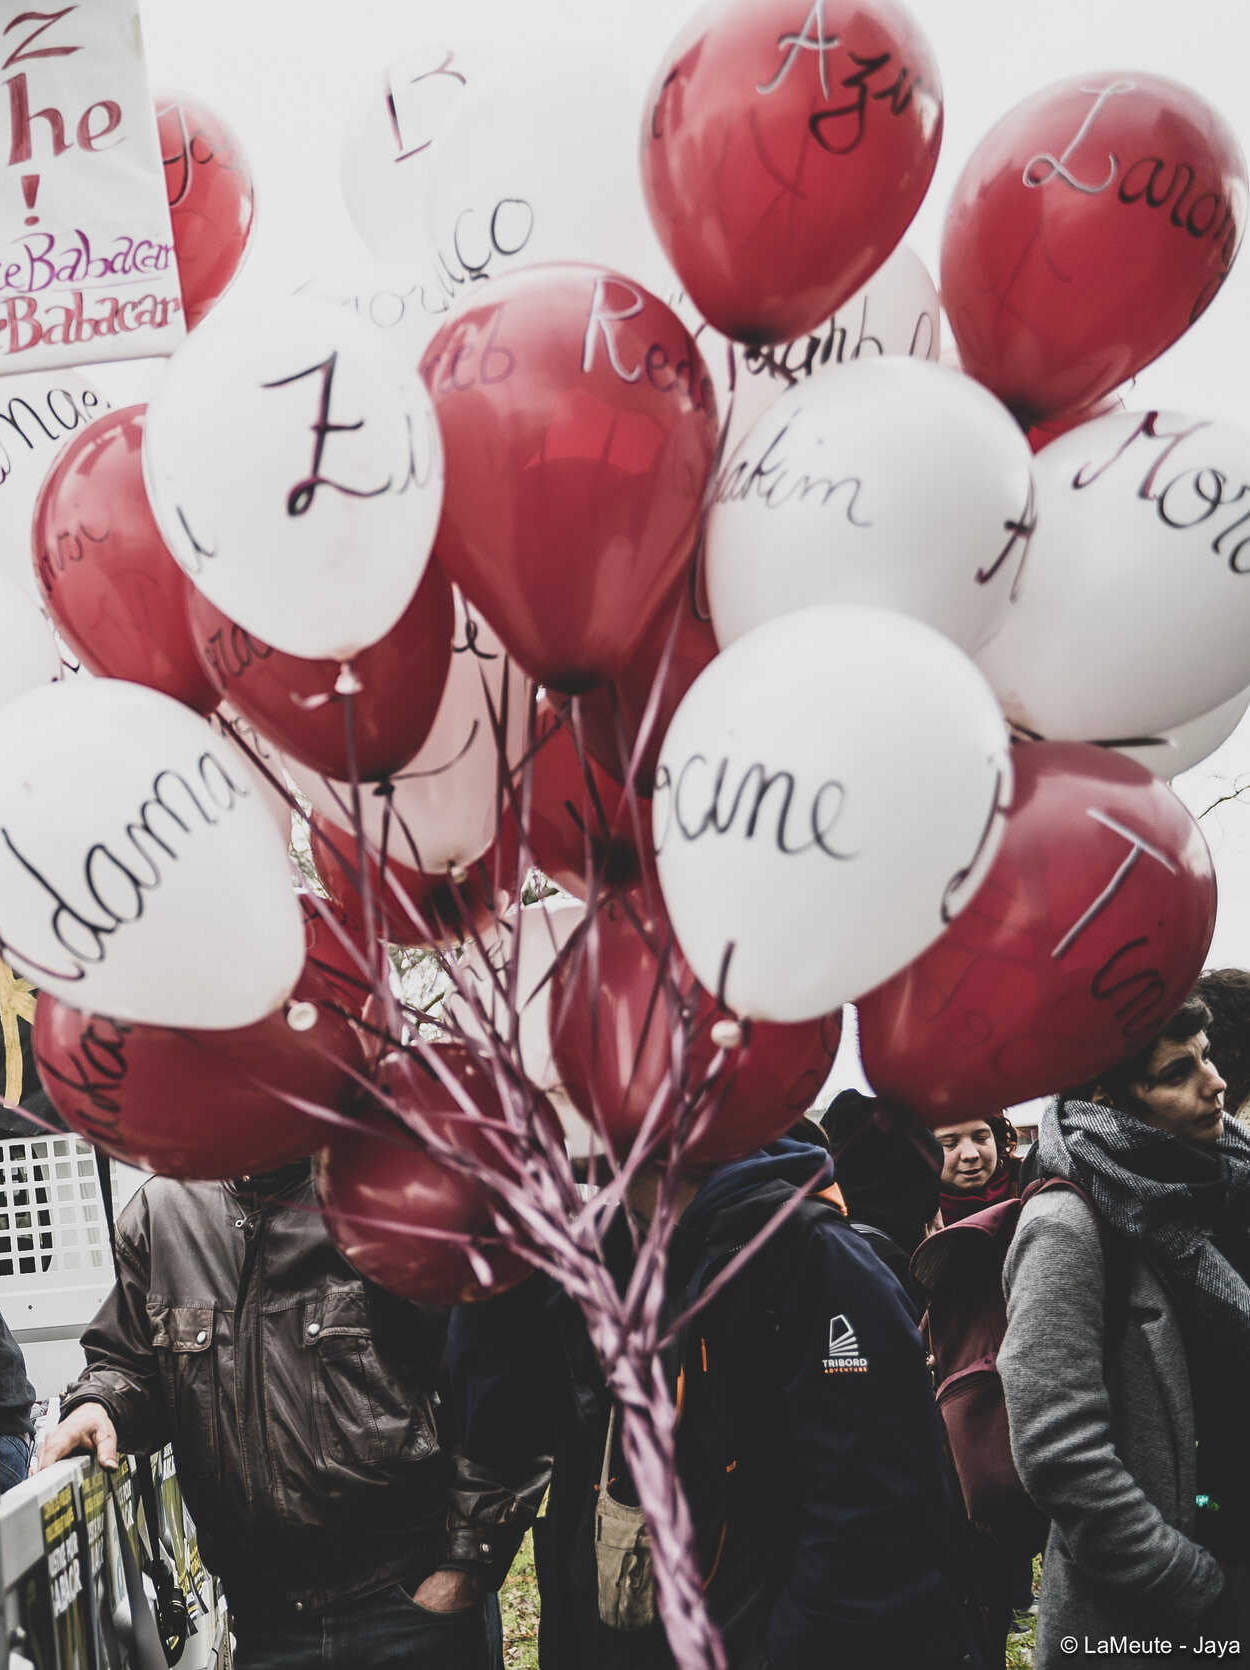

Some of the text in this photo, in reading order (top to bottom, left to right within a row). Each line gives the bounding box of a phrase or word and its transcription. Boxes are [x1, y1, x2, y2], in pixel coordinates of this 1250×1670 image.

[23, 175, 40, 226] !
[822, 1358, 868, 1368] TRIBORD
[824, 1366, 868, 1374] ADVENTURE
